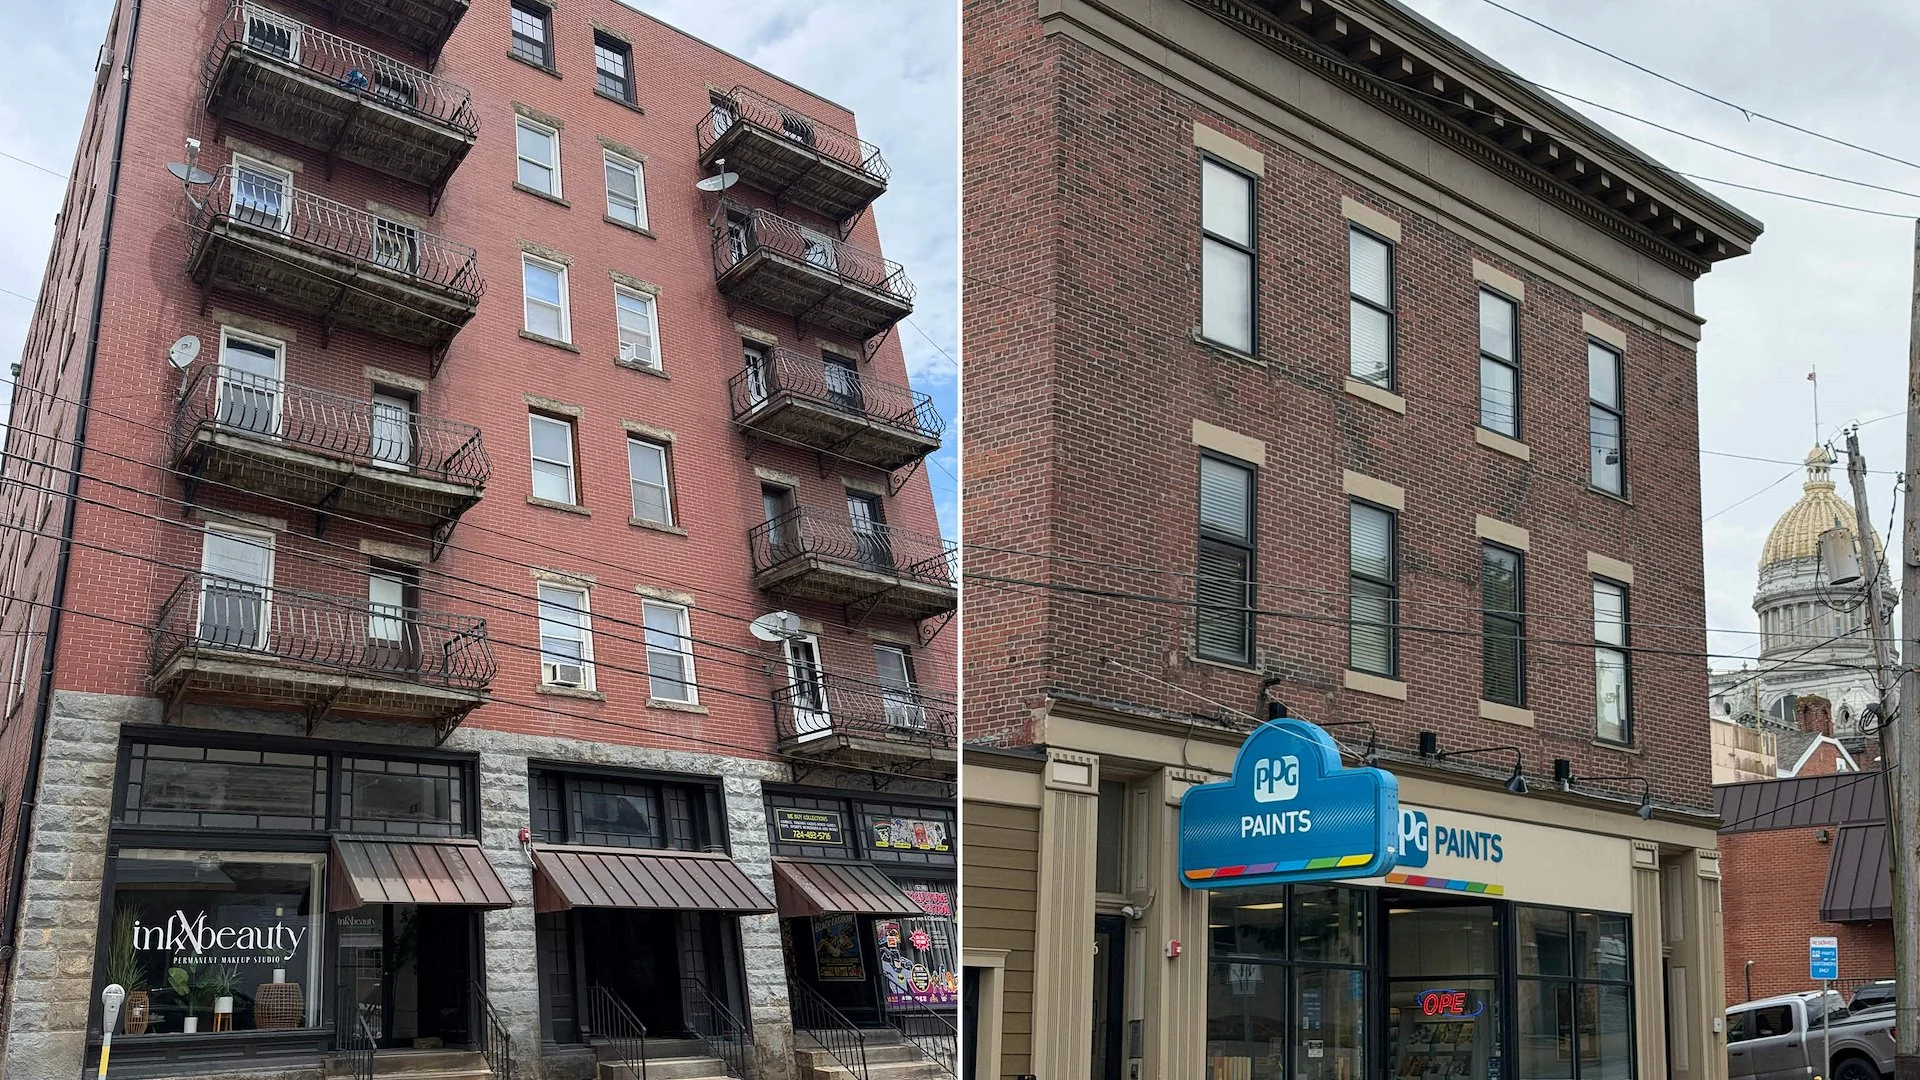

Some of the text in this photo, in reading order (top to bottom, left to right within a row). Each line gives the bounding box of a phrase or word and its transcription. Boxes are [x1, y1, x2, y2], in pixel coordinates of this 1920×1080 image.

[1256, 757, 1297, 794] PPG
[792, 830, 832, 841] 724-493-5716
[1241, 809, 1312, 838] PAINTS
[1435, 825, 1503, 863] PAINTS
[173, 956, 280, 964] PERMANENT MAKEUP STUDIO
